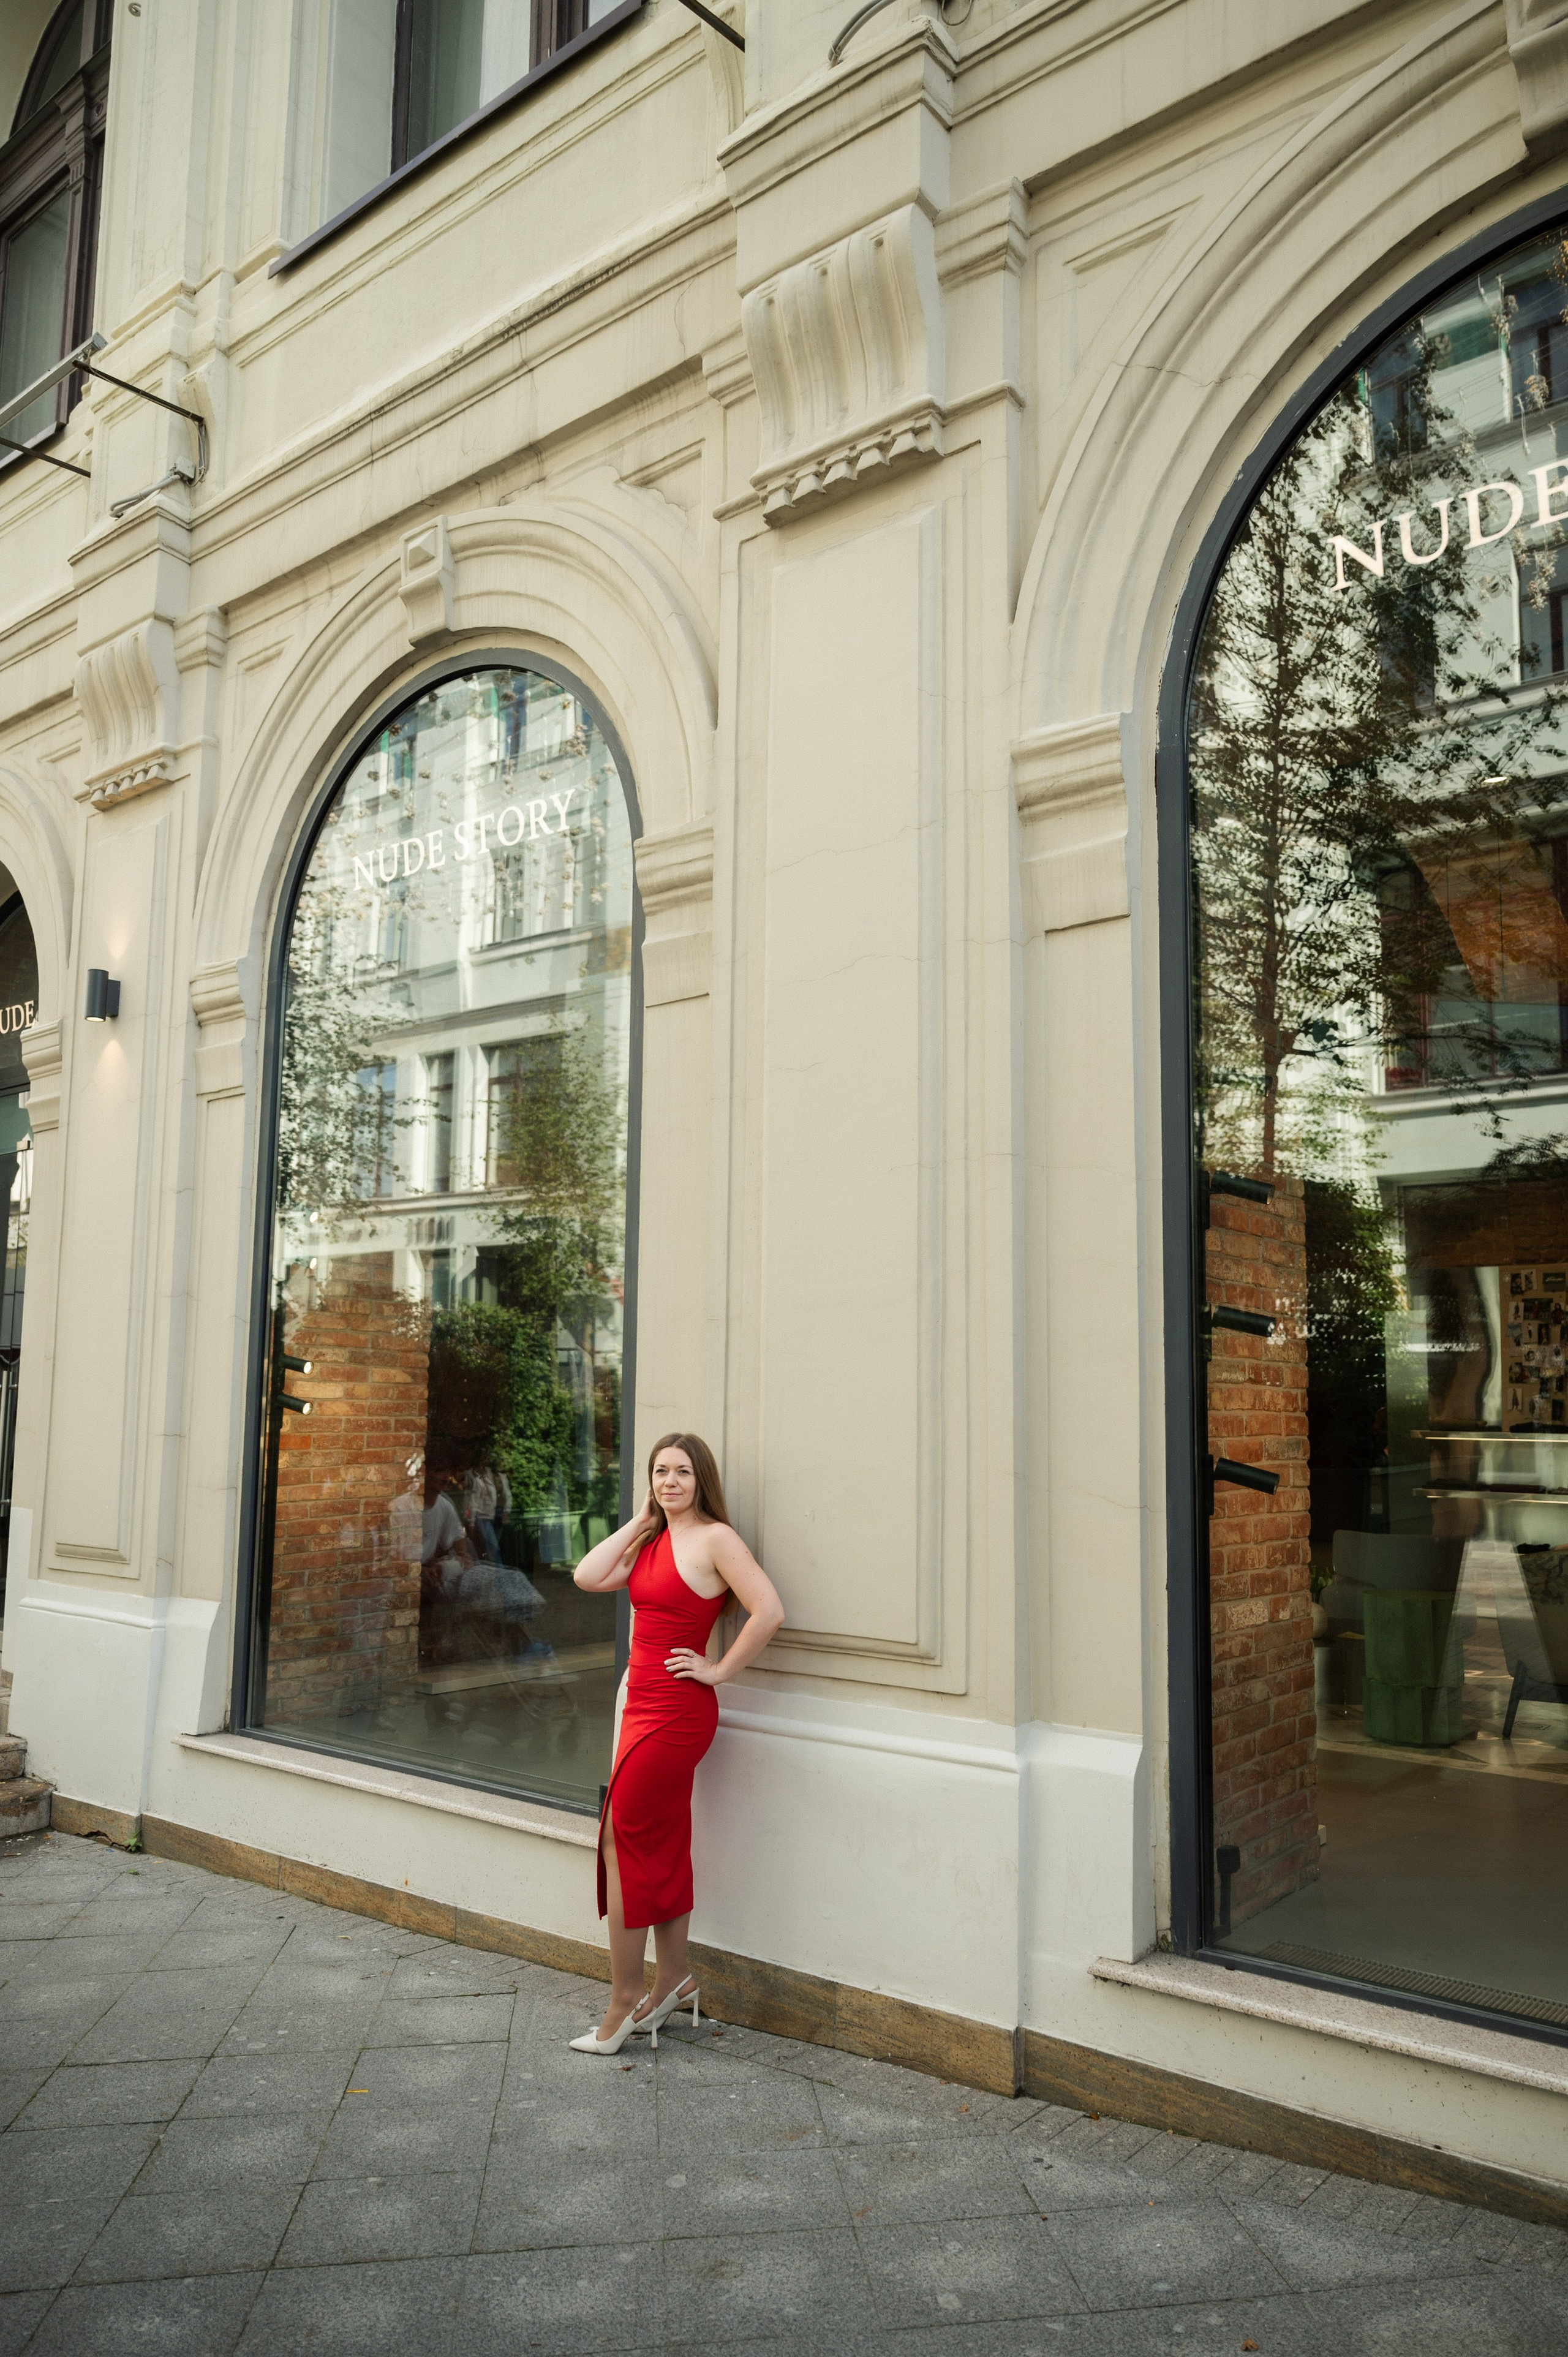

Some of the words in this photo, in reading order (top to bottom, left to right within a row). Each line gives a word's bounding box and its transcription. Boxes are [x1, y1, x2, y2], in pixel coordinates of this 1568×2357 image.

[1327, 458, 1568, 592] NUDE
[352, 829, 445, 891] NUDE
[454, 789, 575, 861] STORY
